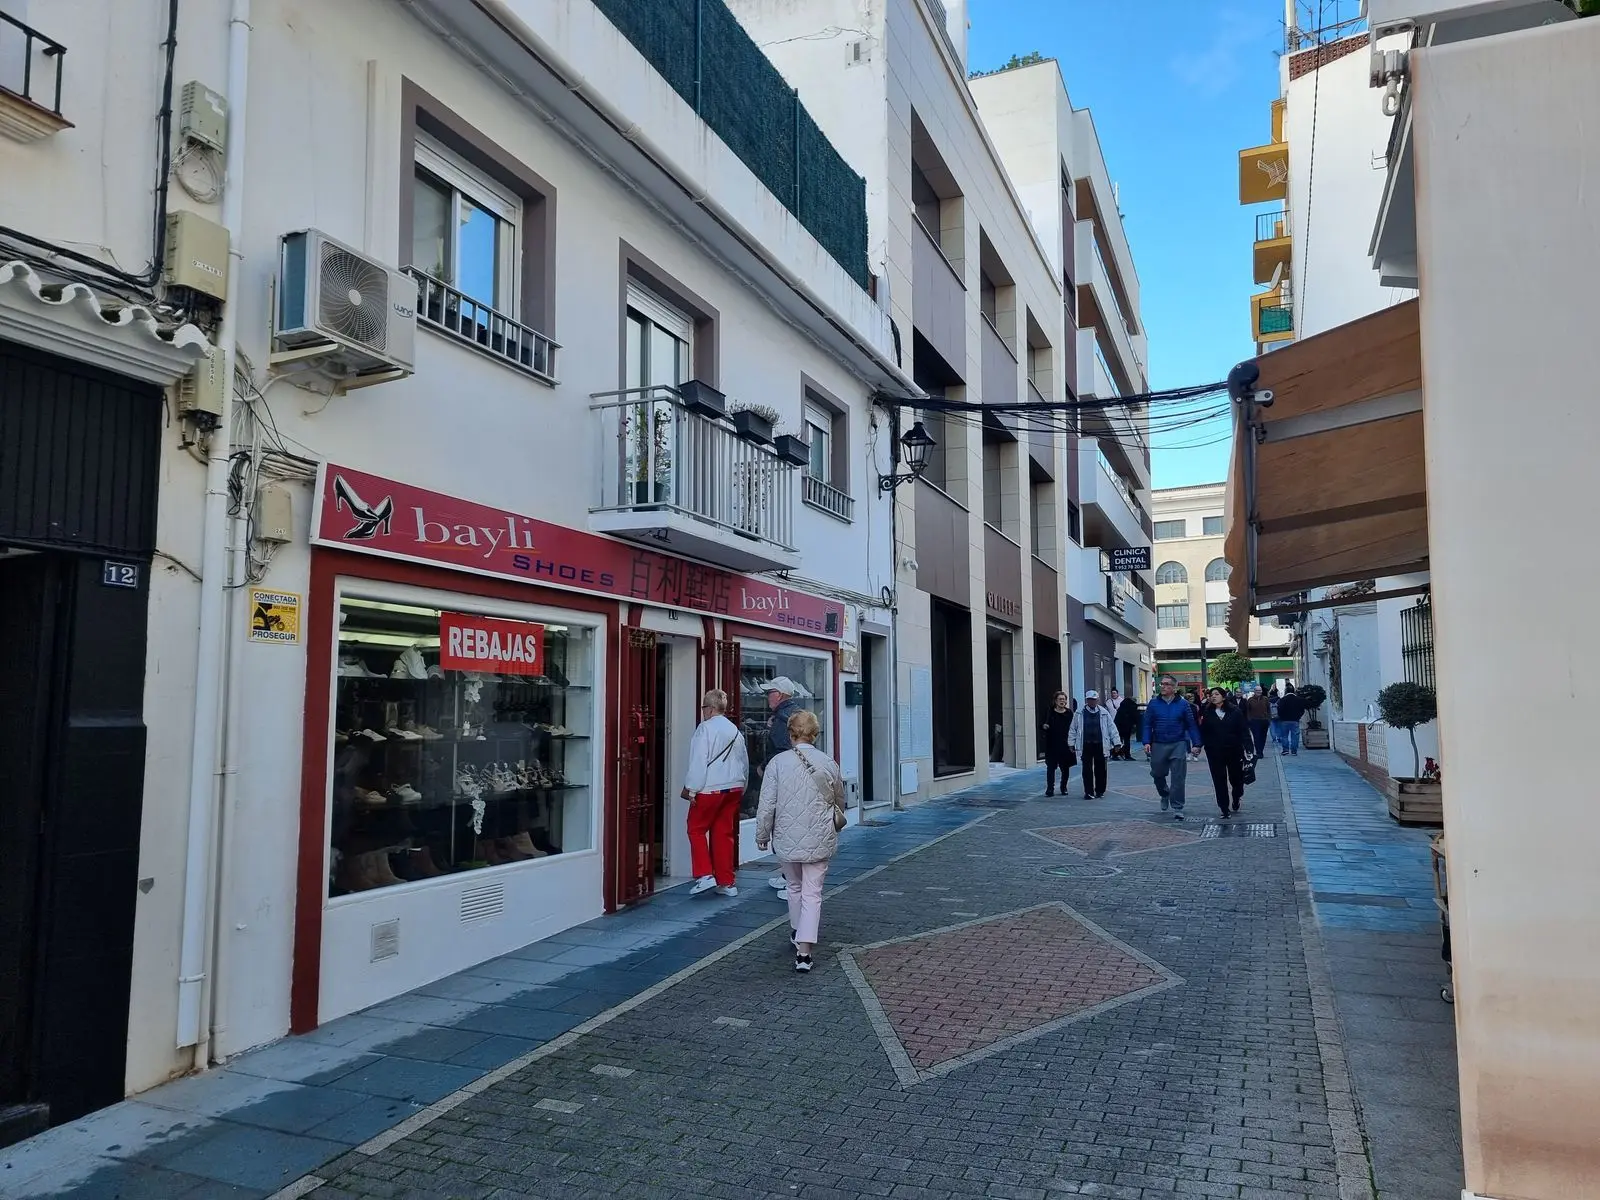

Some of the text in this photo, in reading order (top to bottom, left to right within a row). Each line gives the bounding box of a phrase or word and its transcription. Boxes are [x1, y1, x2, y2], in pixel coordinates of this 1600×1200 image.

[411, 507, 535, 558] bayli
[1114, 548, 1147, 556] CLINICA
[1114, 556, 1146, 565] DENTAL
[109, 566, 134, 583] 12
[512, 554, 615, 588] SHOES
[253, 592, 297, 603] CONECTADA
[741, 587, 790, 617] bayli
[776, 612, 822, 631] SHOES
[252, 630, 296, 641] PROSEGUR
[448, 625, 537, 664] REBAJAS
